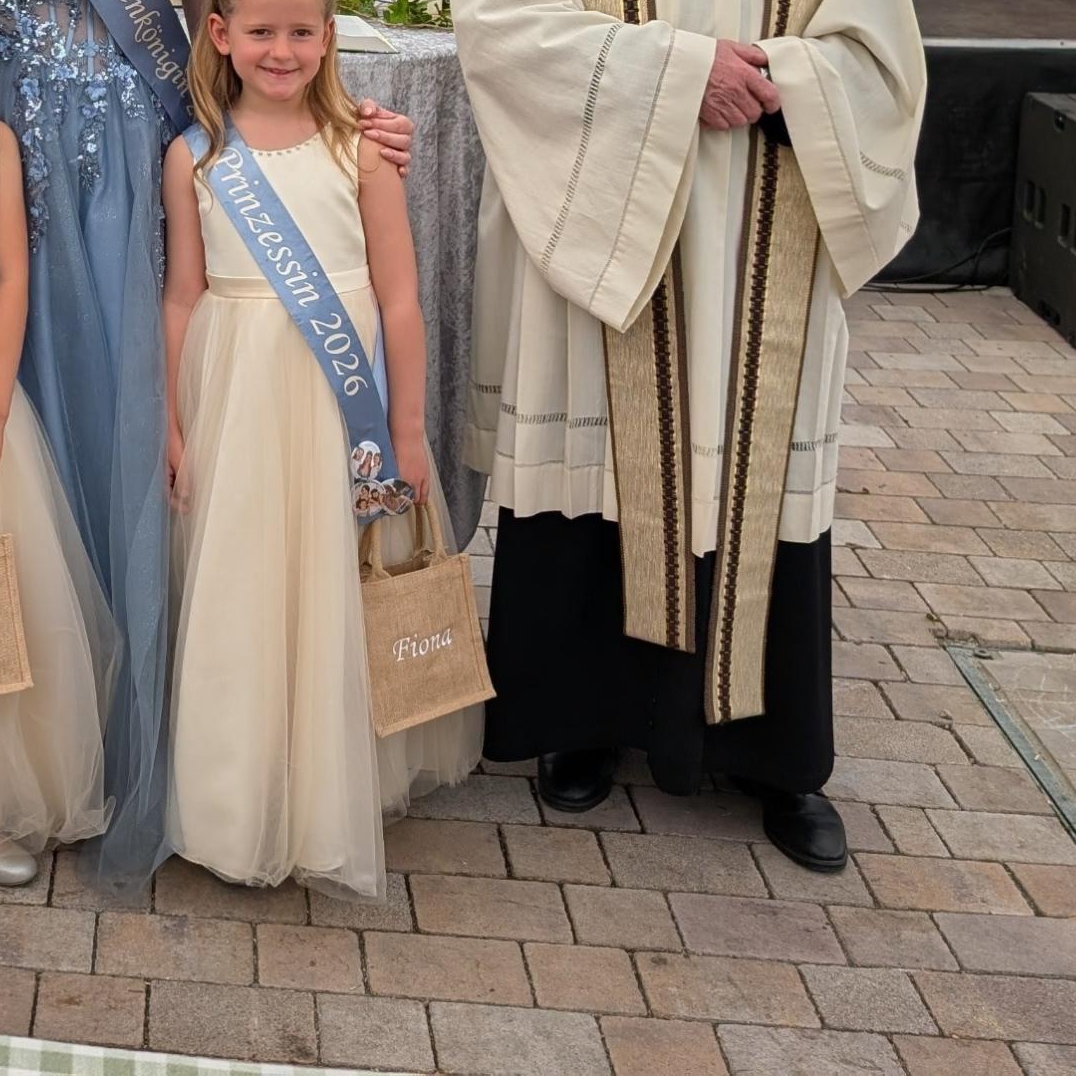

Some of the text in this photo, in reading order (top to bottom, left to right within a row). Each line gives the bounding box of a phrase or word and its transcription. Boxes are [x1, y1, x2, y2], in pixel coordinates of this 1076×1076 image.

[213, 147, 369, 397] Prinzessin 2026
[393, 627, 453, 662] Fiona
